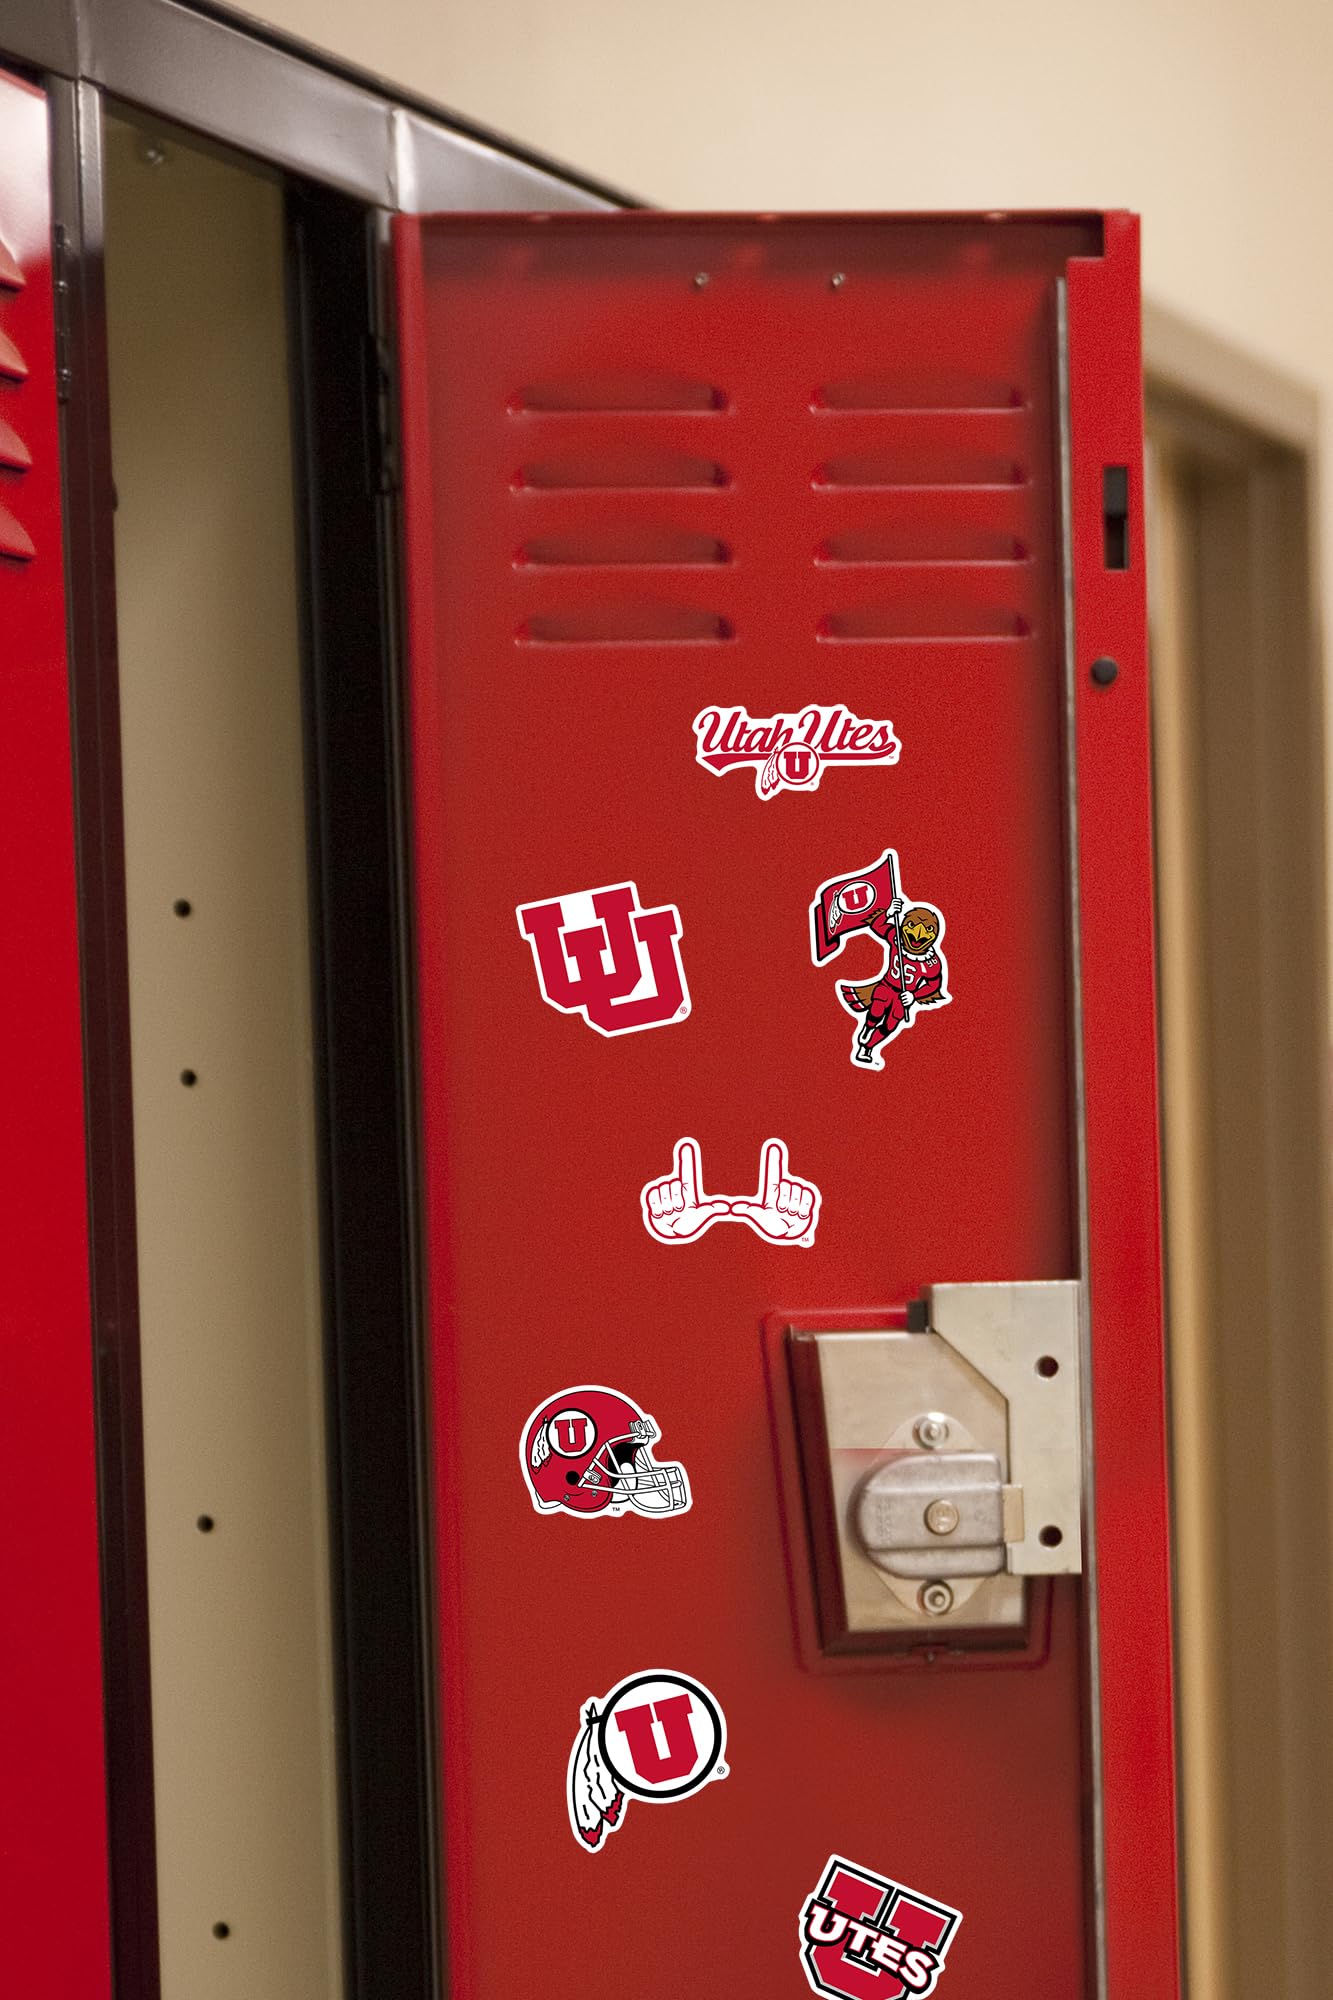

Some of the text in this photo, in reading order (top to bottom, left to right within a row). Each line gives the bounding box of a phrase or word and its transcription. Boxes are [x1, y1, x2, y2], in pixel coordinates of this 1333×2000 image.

[697, 709, 890, 752] Utah Utes
[784, 751, 811, 780] U
[841, 885, 869, 911] U
[554, 1417, 588, 1453] U
[614, 1693, 699, 1784] U
[807, 1903, 935, 1988] UTES
[810, 1866, 954, 2000] U
